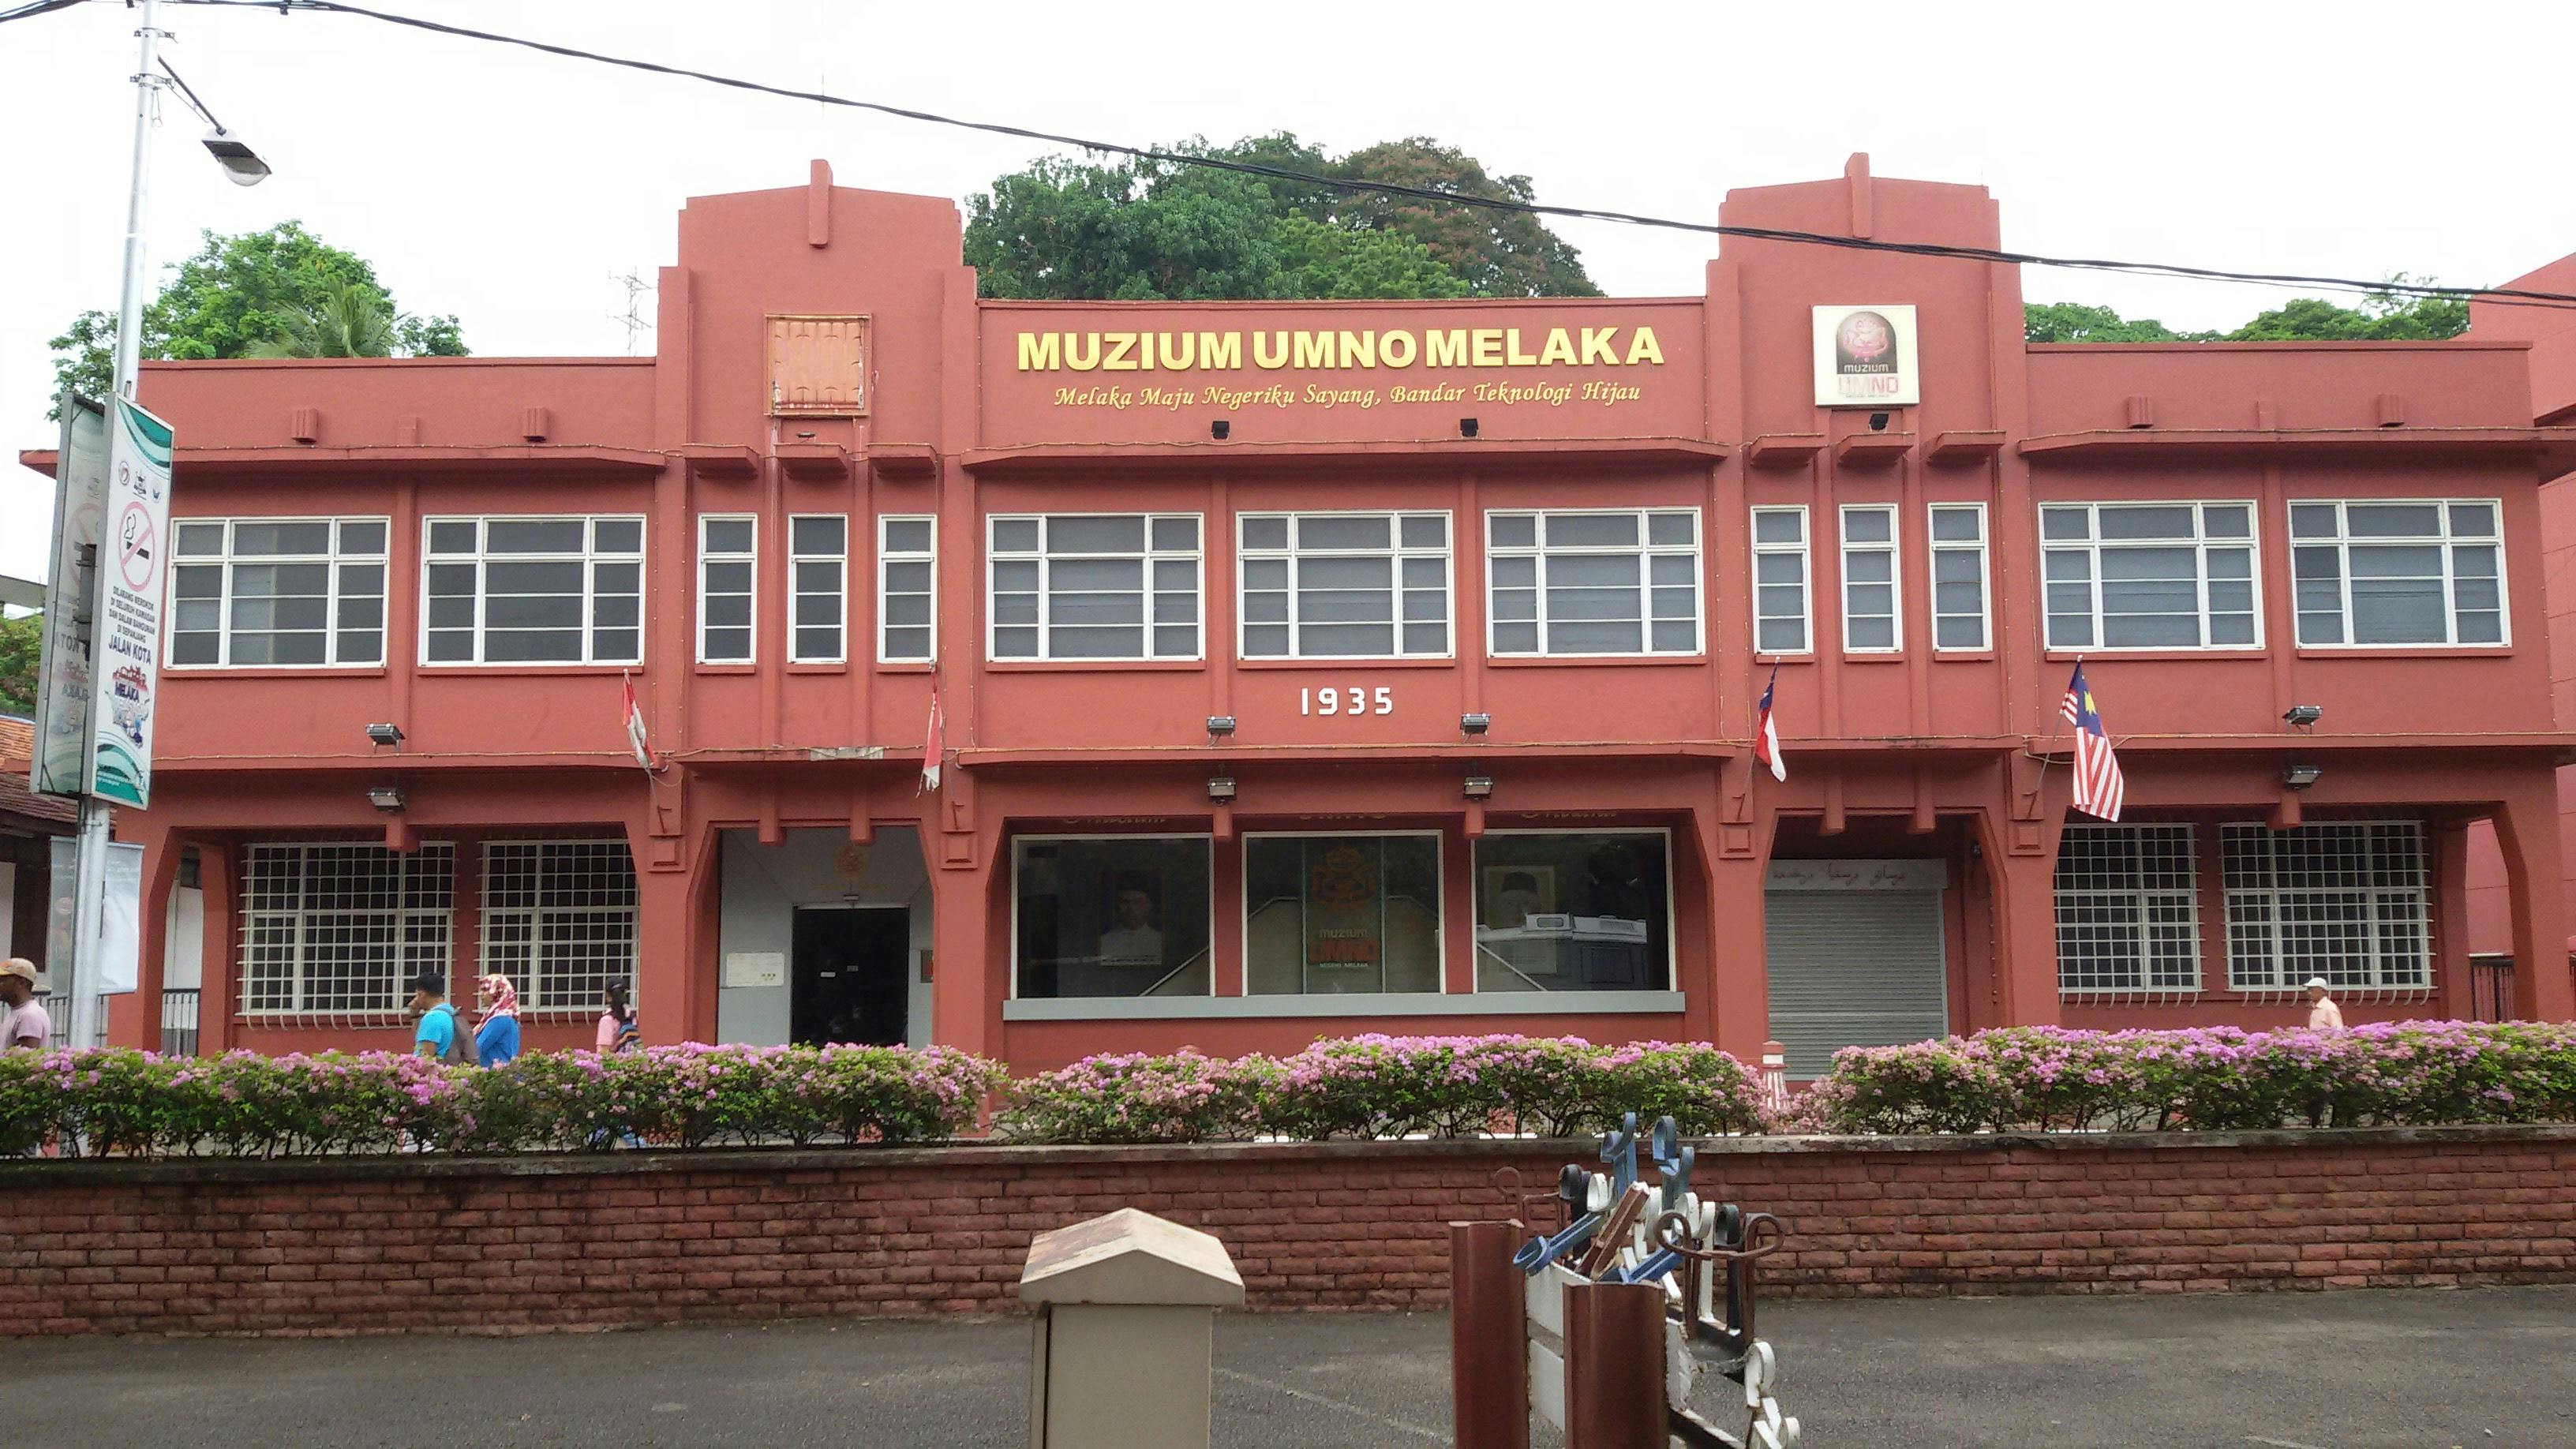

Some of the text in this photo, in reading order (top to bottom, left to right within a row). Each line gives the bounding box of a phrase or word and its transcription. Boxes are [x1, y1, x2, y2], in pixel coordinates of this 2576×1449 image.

[1017, 326, 1665, 371] MUZIUM UMNO MELAKA
[1844, 363, 1889, 373] muzium
[1054, 380, 1641, 410] Melaka Maju Negeriku Sayang, Bandar Teknologi Hijau
[108, 634, 152, 665] JALAN KOTA
[114, 681, 140, 702] MELAKA
[1301, 687, 1394, 716] 1935
